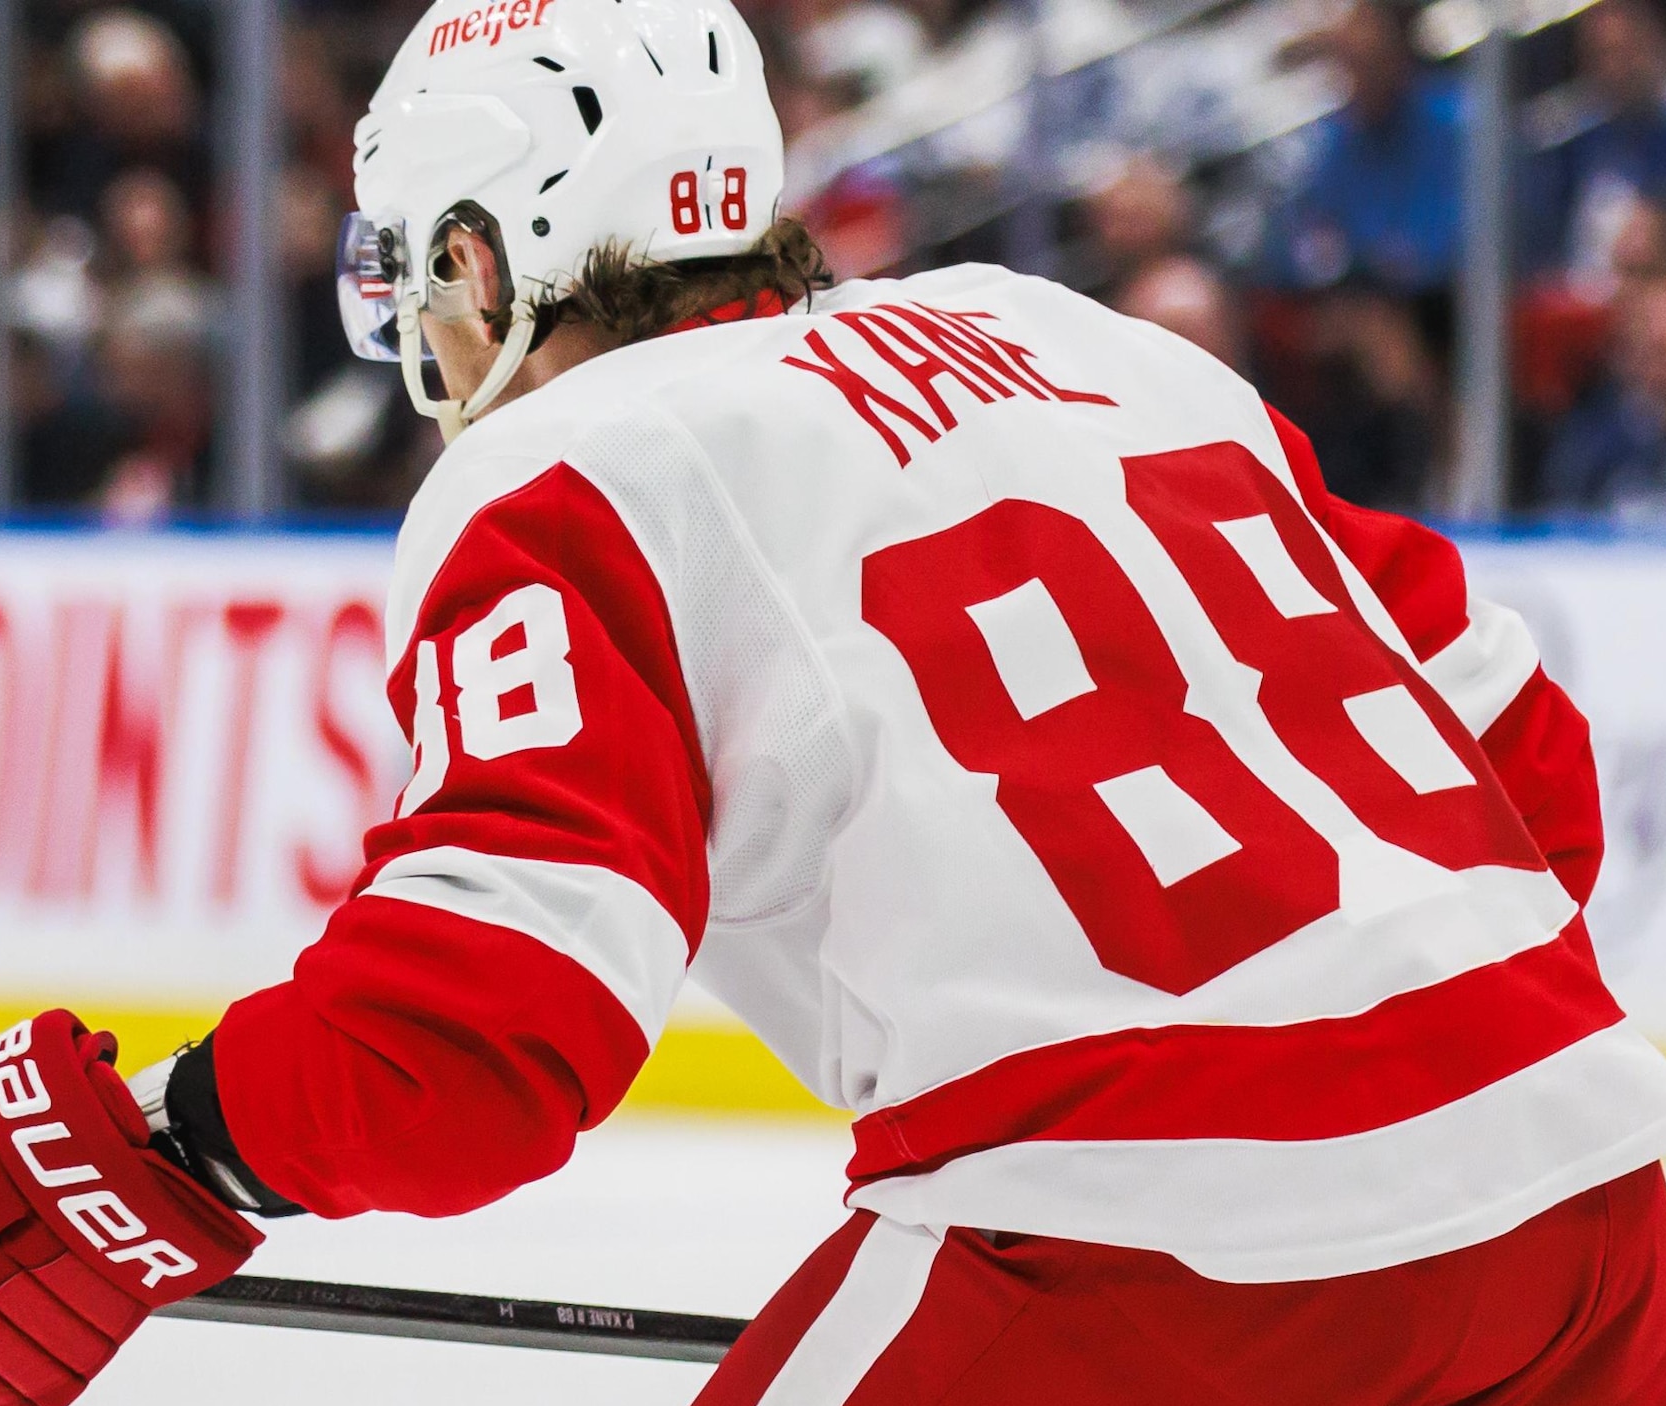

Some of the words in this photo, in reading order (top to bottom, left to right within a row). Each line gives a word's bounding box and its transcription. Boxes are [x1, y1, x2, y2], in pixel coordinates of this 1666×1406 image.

[429, 0, 554, 57] meijer
[670, 166, 747, 235] 88
[779, 299, 1120, 470] KANE
[861, 440, 1548, 997] 88
